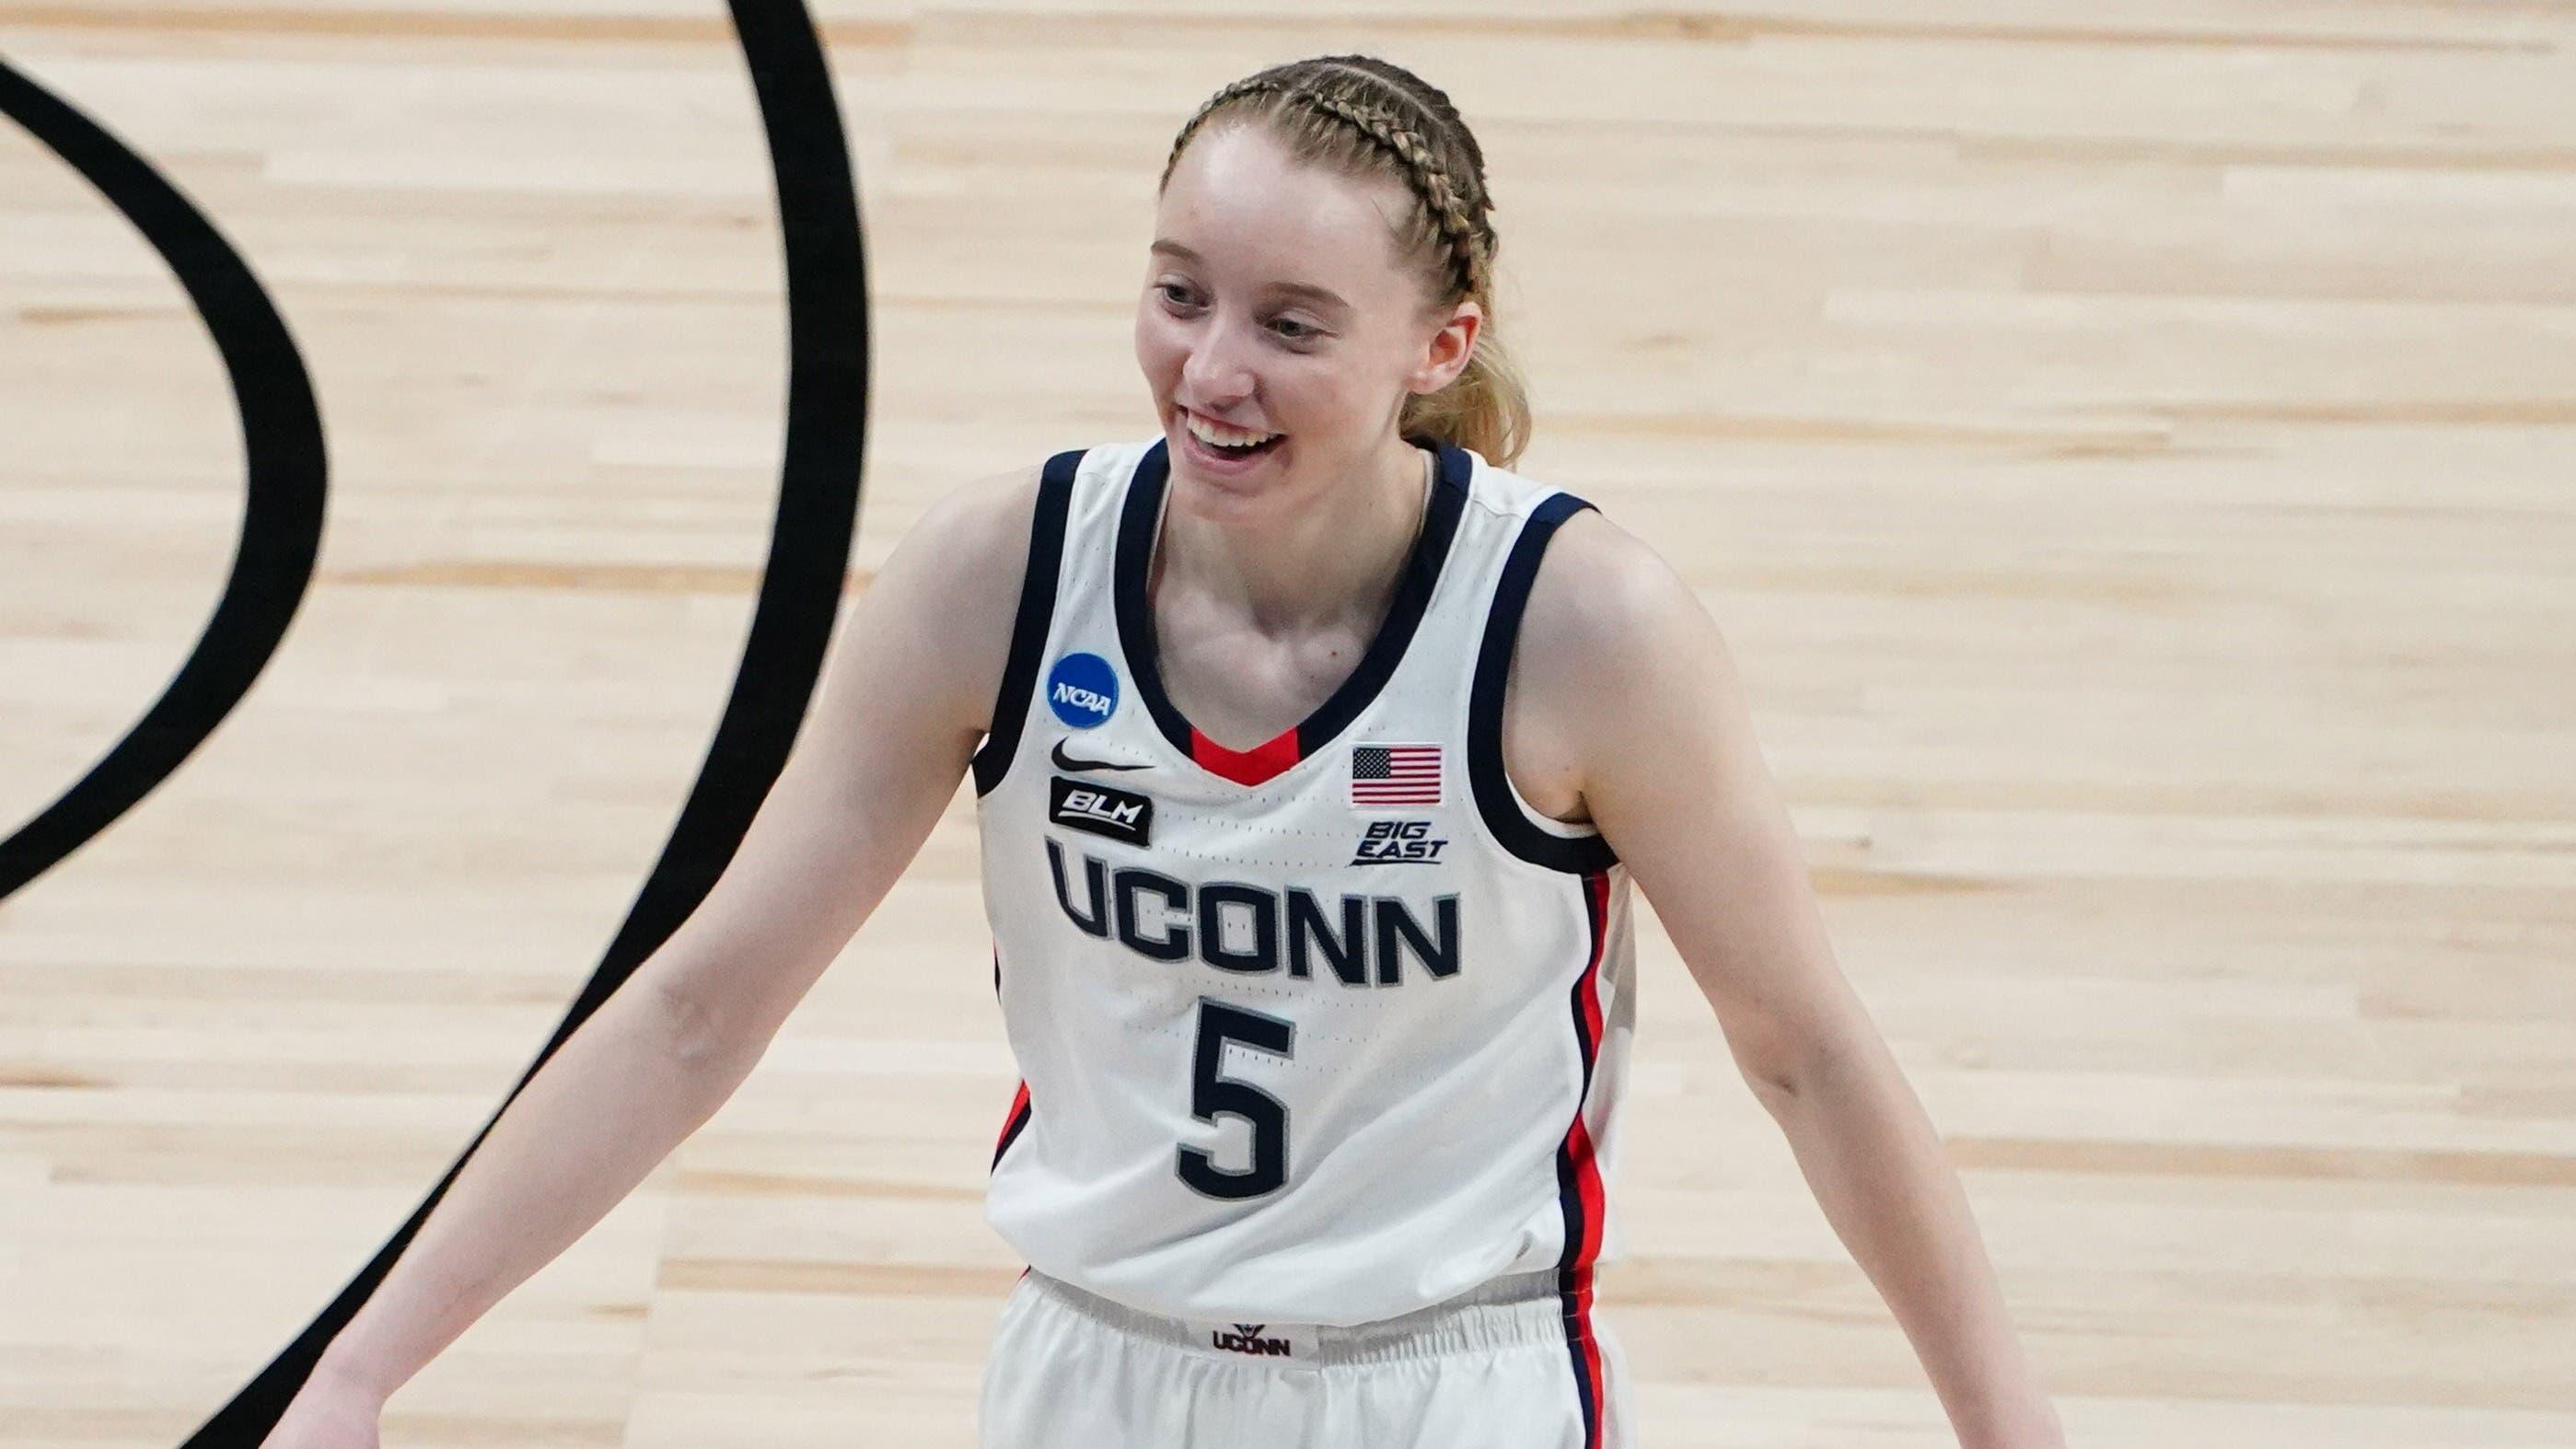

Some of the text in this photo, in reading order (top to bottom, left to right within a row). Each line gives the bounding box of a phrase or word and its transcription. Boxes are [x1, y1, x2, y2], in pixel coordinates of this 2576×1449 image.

[1052, 681, 1112, 716] NCAA
[1062, 788, 1144, 824] BLM
[1365, 820, 1432, 839] BIG
[1355, 839, 1449, 859] EAST
[1044, 834, 1462, 988] UCONN
[1174, 995, 1296, 1202] 5
[1213, 1330, 1292, 1357] UCONN
